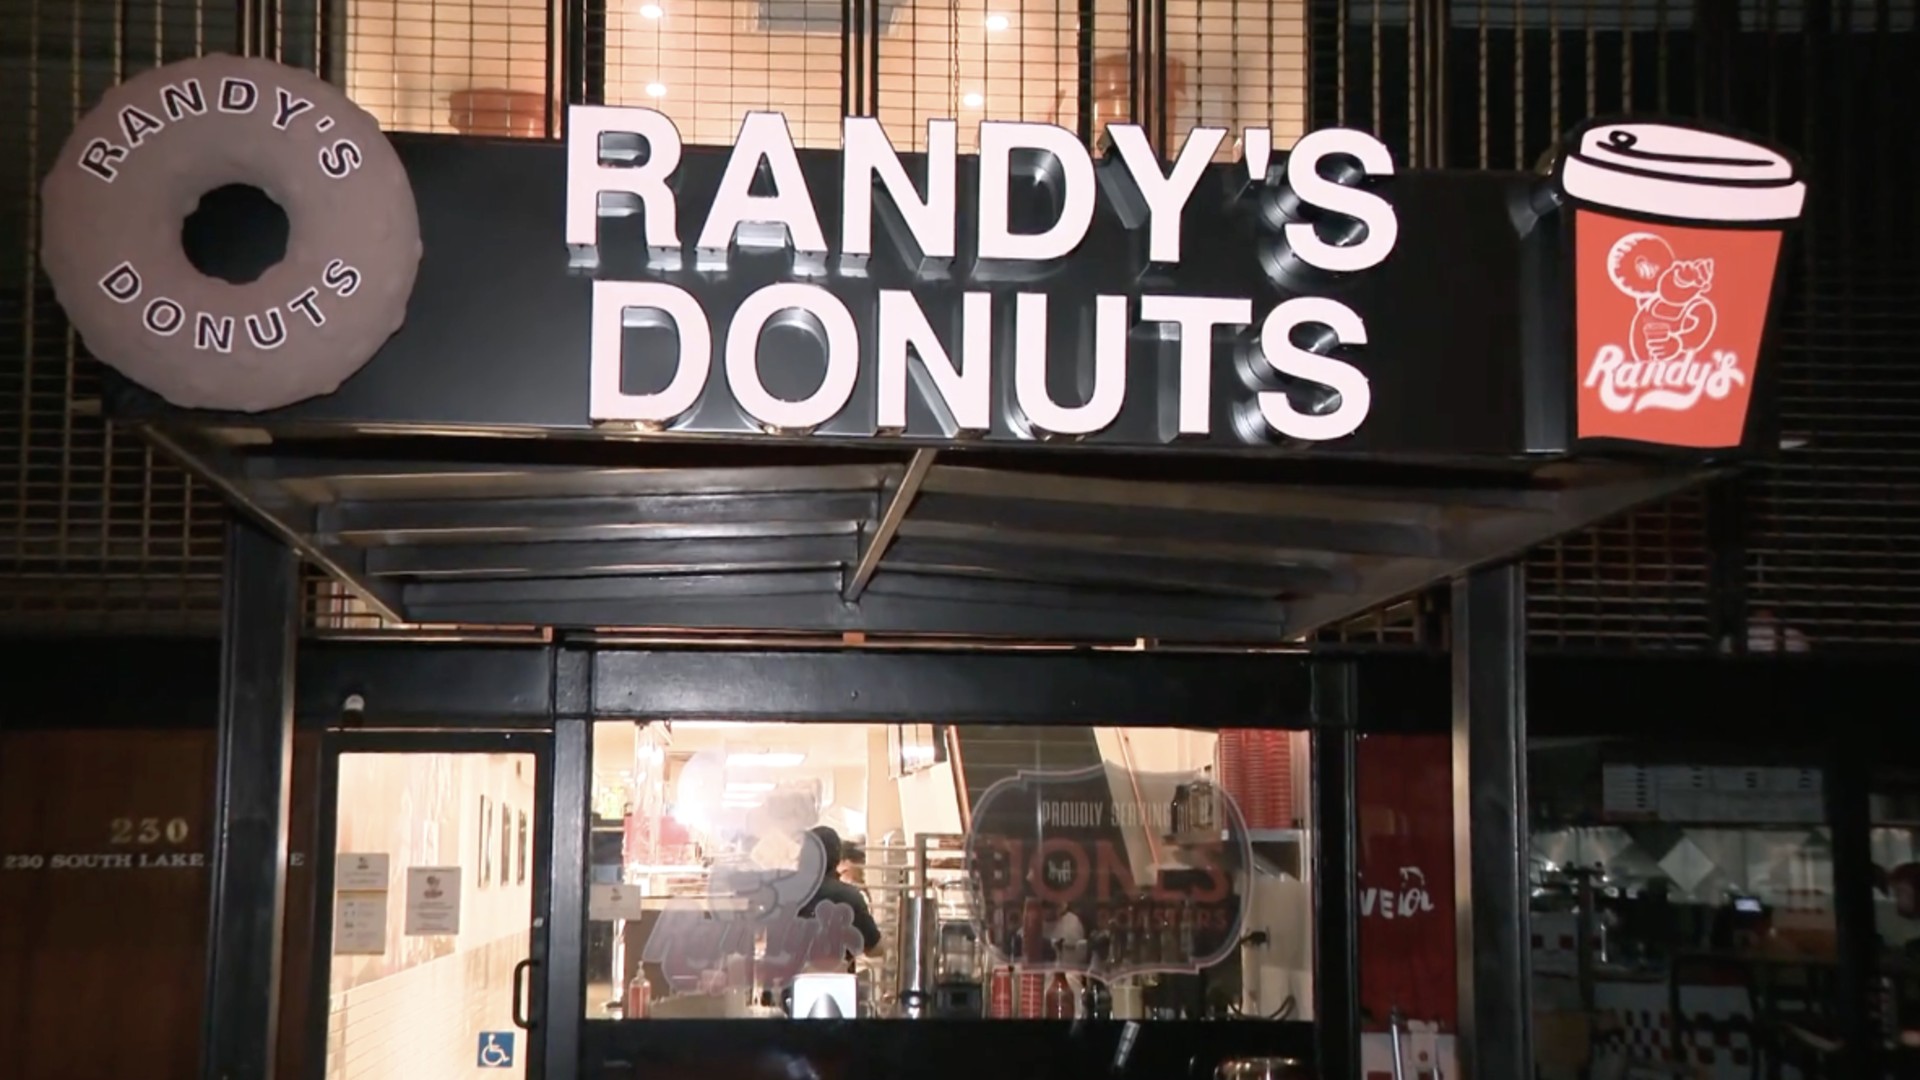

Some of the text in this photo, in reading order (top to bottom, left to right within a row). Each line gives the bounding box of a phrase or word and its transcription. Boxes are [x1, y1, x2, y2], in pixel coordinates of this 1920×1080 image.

[79, 77, 362, 182] RANDY'S
[566, 105, 1398, 272] RANDY'S
[99, 257, 362, 354] DONUTS
[588, 279, 1371, 441] DONUTS
[1584, 343, 1745, 415] Randy's
[109, 817, 189, 844] 230
[1042, 800, 1104, 828] PROUDLY
[3, 853, 205, 869] 230 SOUTH LAKE
